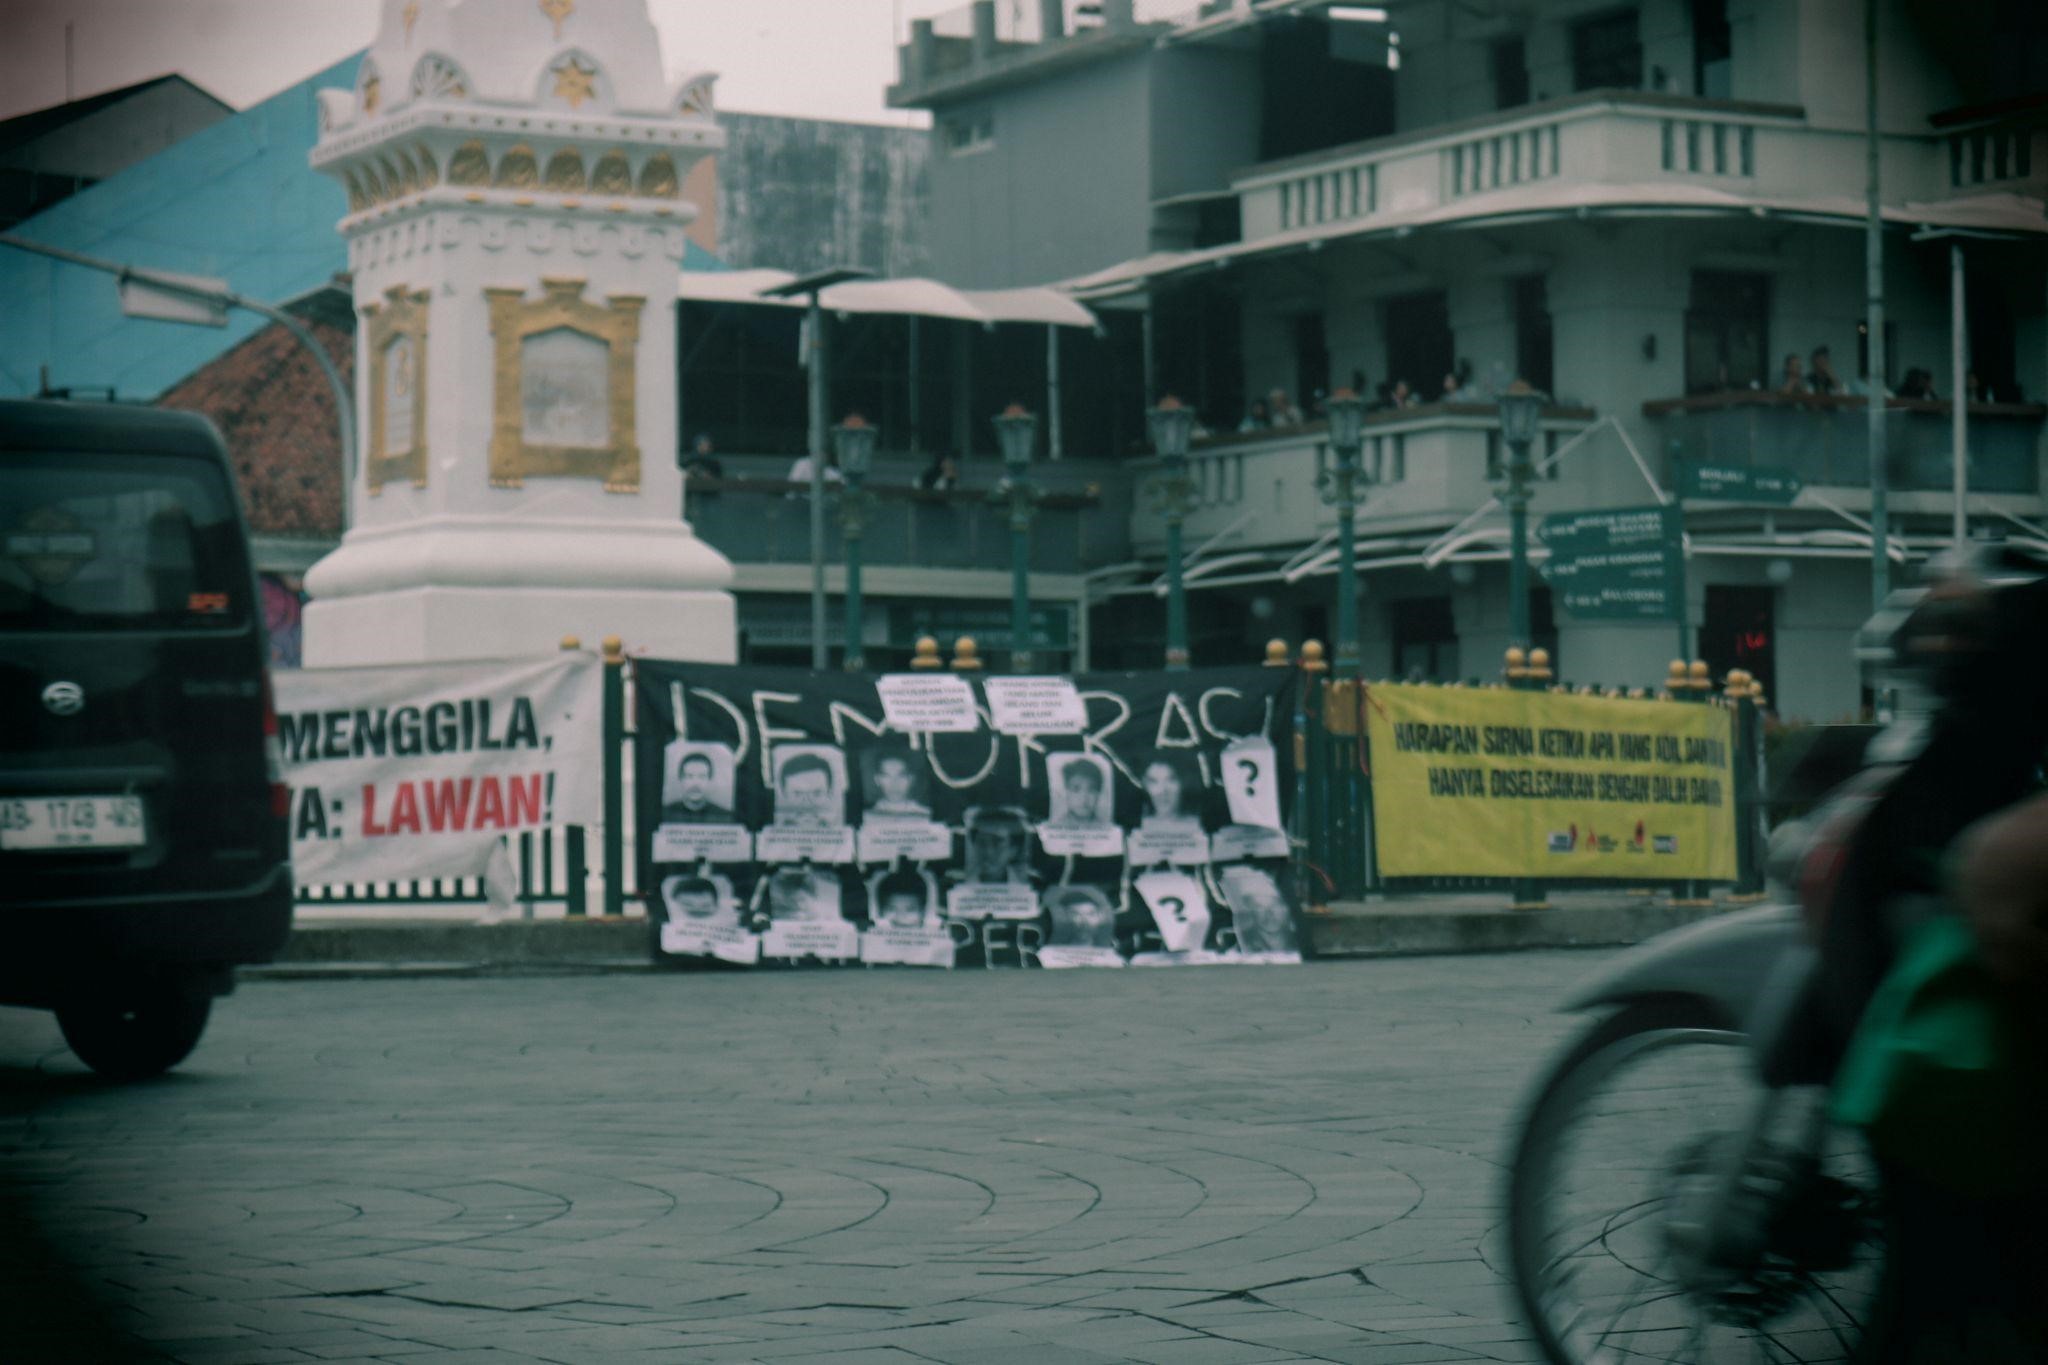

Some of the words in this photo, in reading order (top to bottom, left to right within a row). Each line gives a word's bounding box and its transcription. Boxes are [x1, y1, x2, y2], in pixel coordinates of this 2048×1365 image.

[279, 696, 553, 764] MENGGILA,
[1394, 722, 1478, 755] HARAPAN
[1483, 726, 1534, 757] SIRNA
[1589, 730, 1614, 759] APA
[361, 772, 556, 837] LAWAN!
[1428, 767, 1486, 797] HANYA
[1490, 768, 1594, 801] DISELESAIKAN
